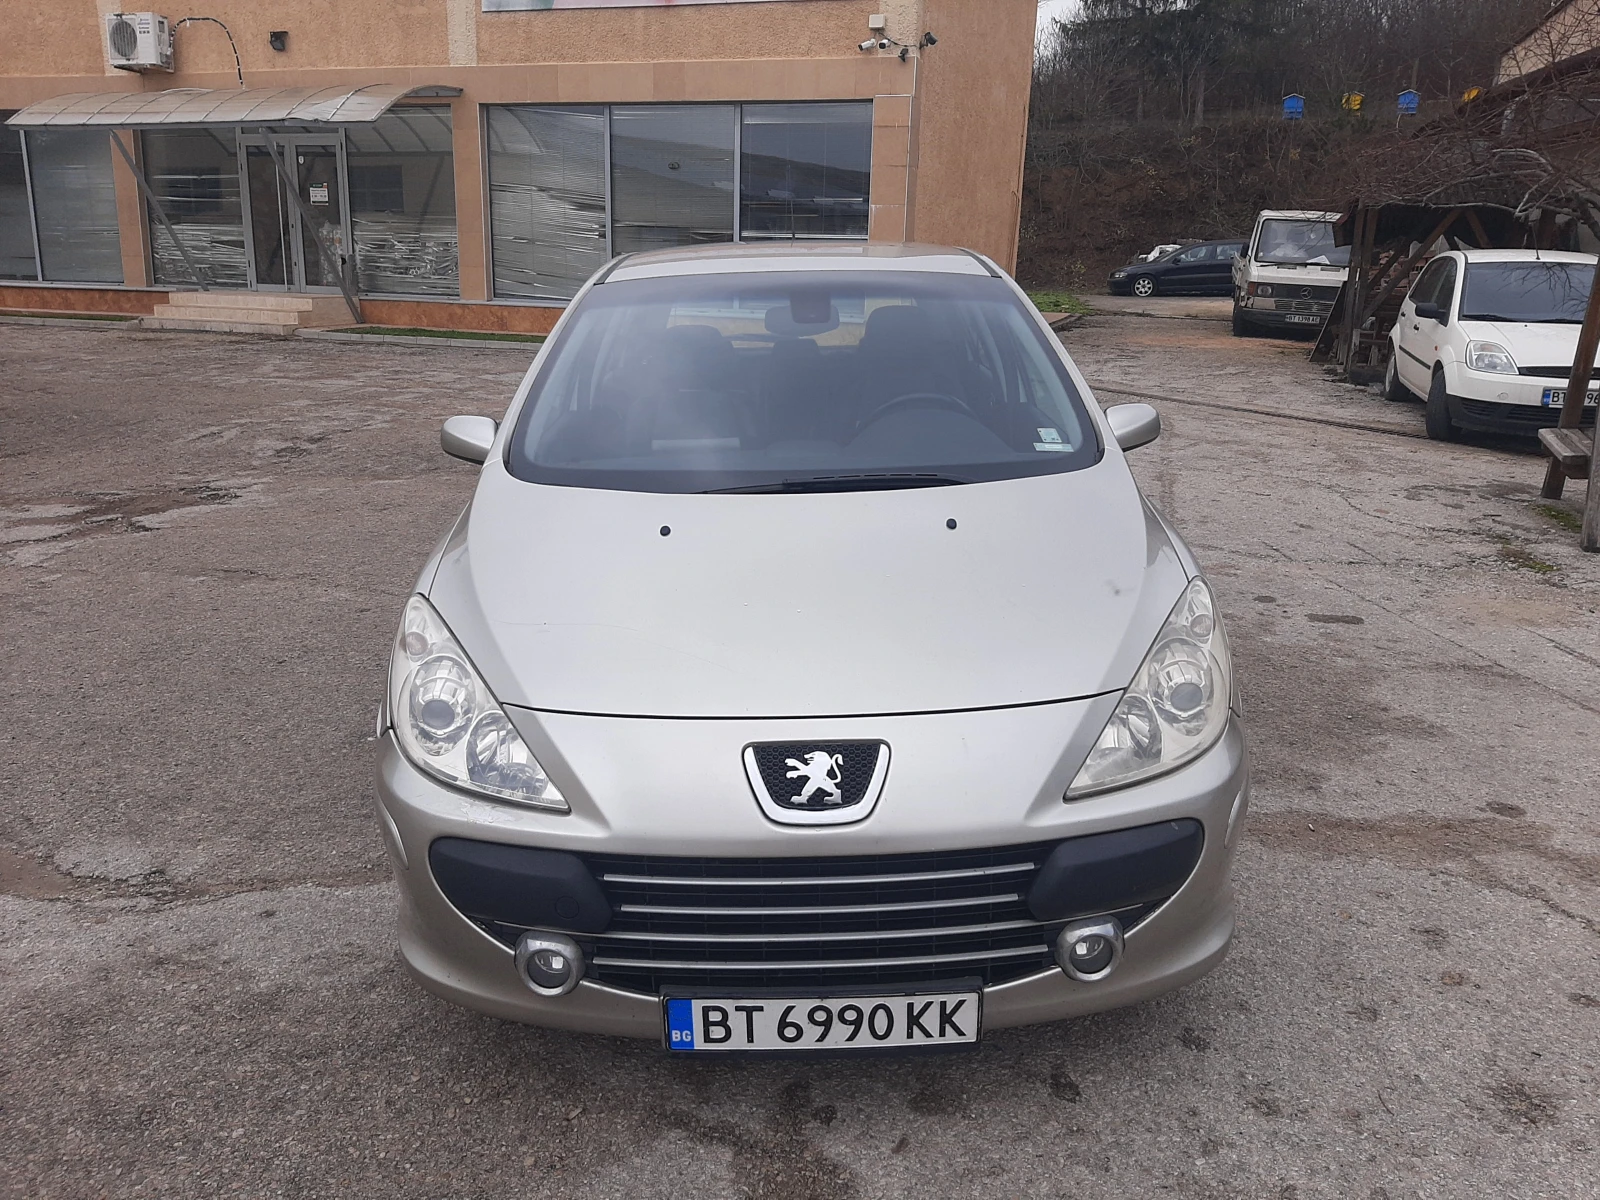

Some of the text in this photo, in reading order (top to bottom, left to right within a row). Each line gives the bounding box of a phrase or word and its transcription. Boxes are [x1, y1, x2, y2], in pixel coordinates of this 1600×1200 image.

[702, 999, 968, 1044] BT 6990 KK
[671, 1030, 692, 1042] BG
